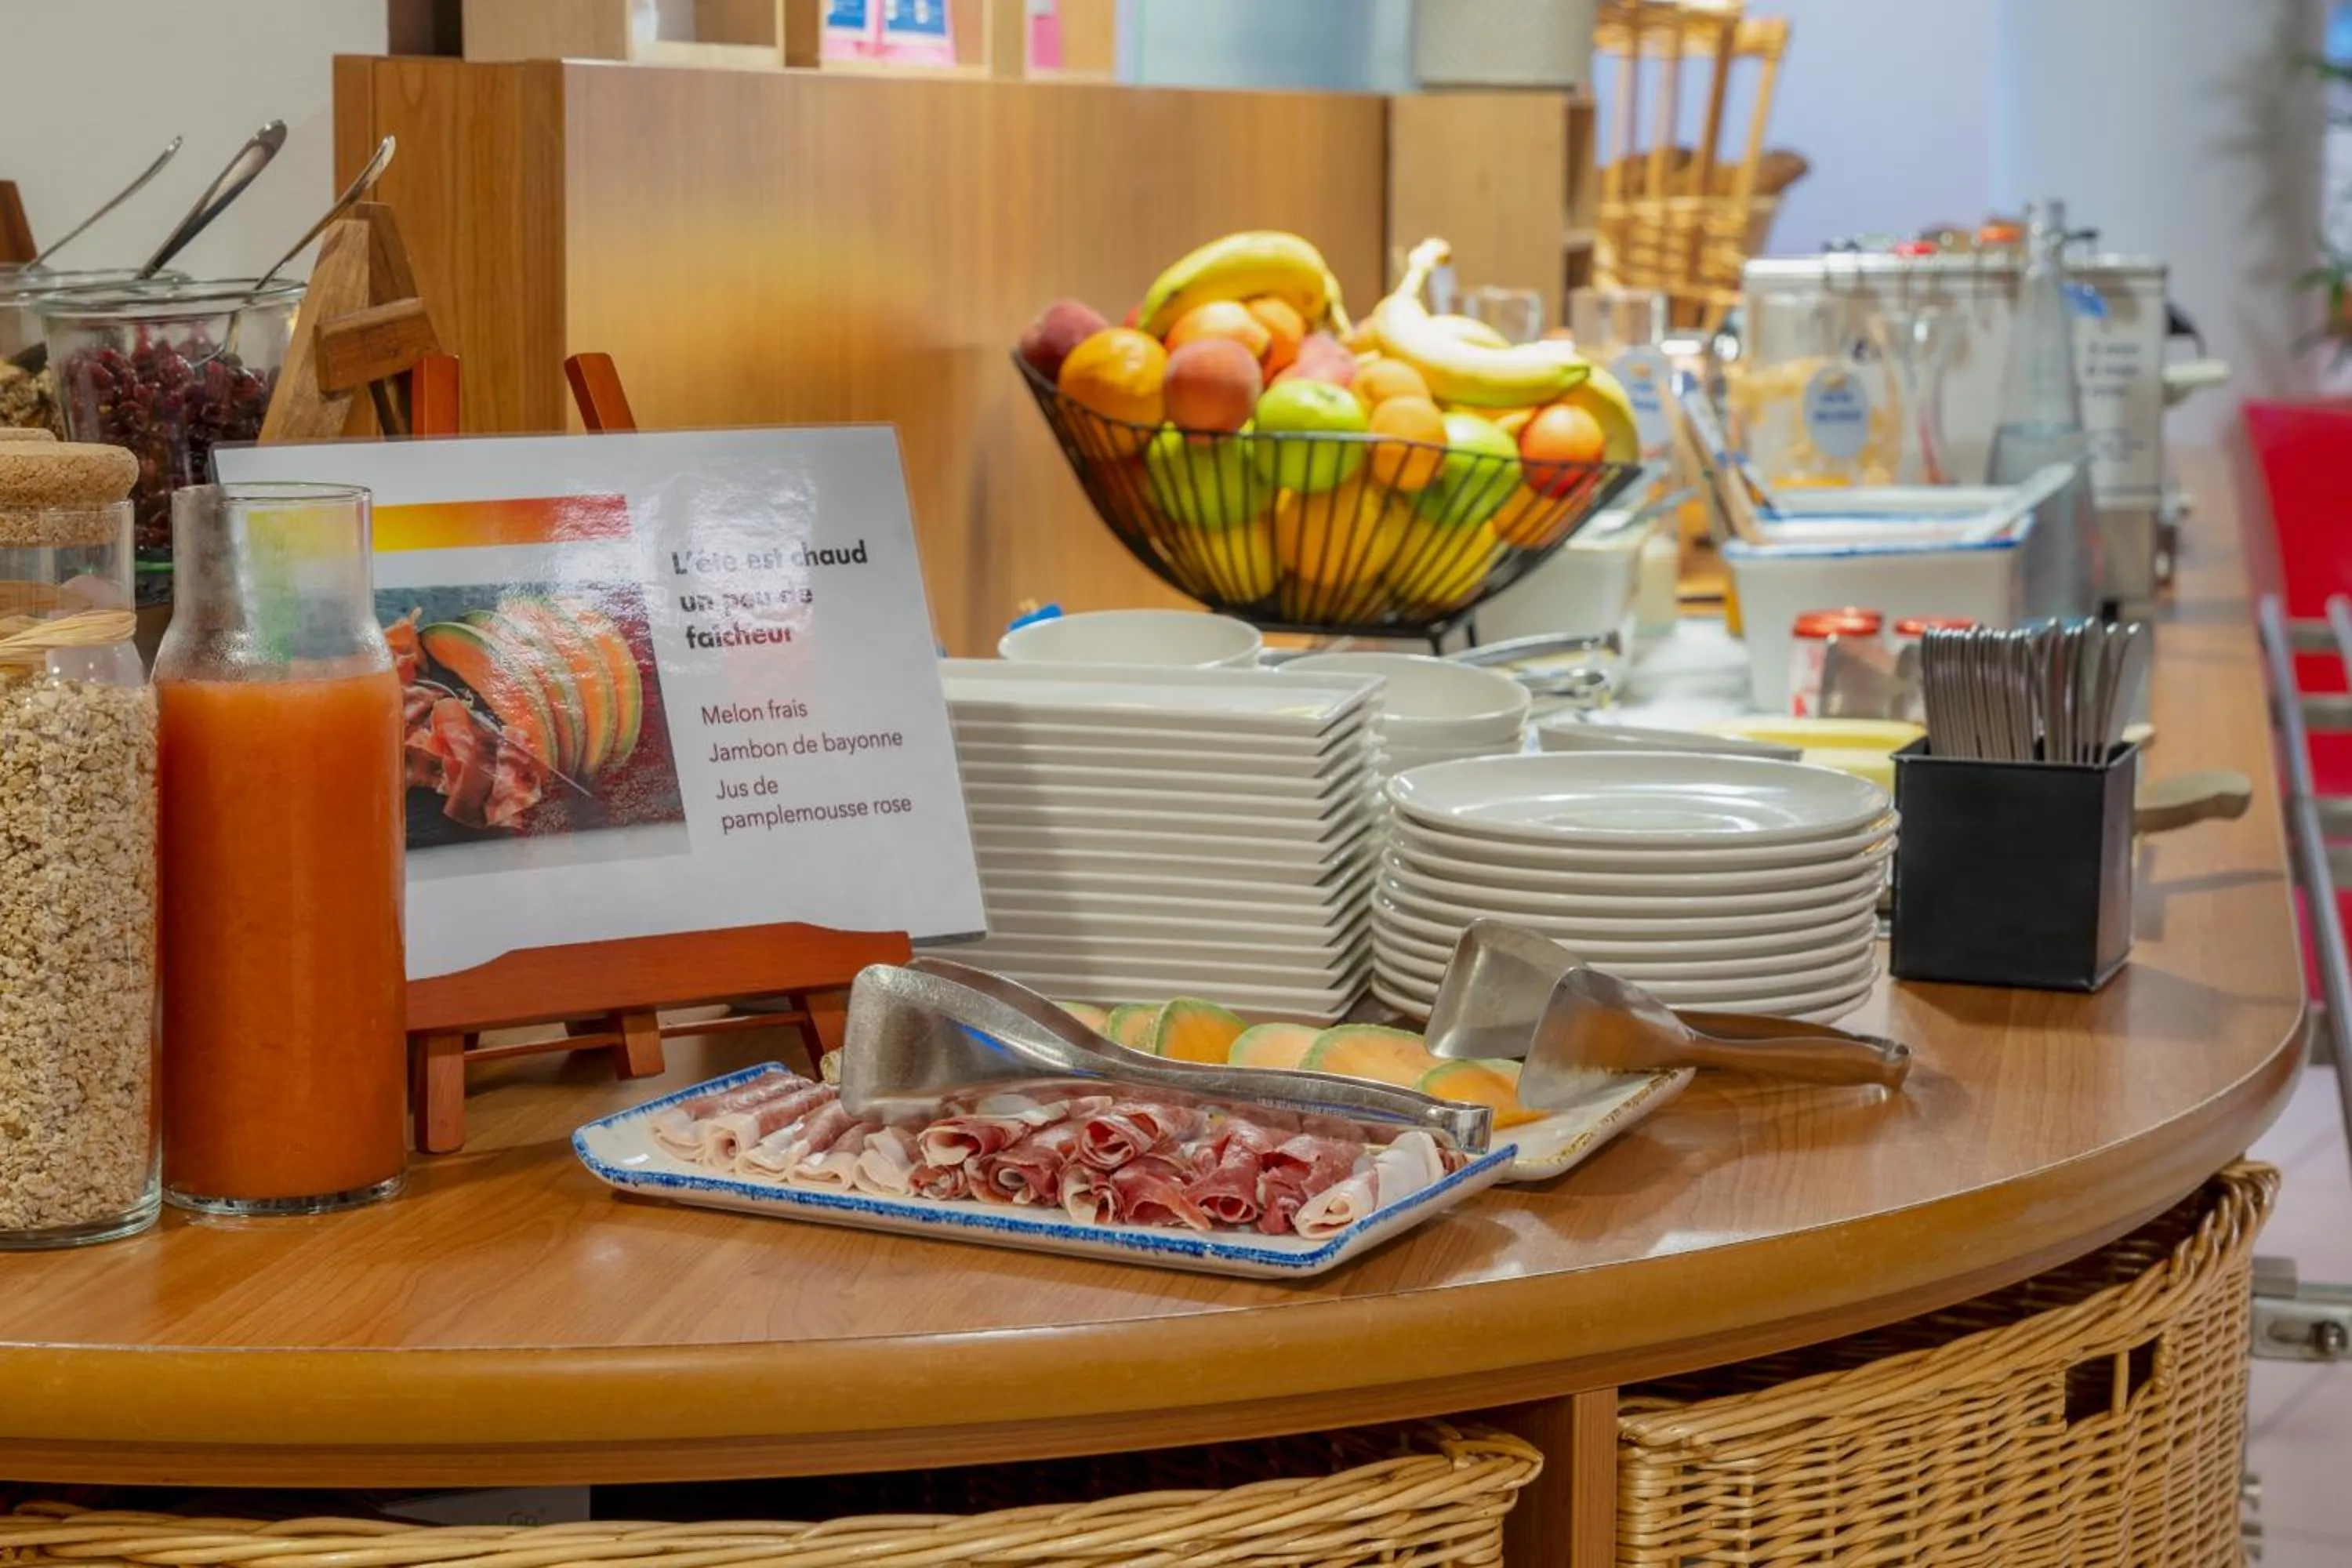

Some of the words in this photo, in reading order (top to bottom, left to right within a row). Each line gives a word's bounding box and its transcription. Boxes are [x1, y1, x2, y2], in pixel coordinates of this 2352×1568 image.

[747, 547, 785, 570] est
[791, 539, 868, 566] chaud
[680, 593, 714, 612] un
[701, 703, 764, 726] Melon
[768, 699, 808, 720] frais
[709, 739, 789, 763] Jambon
[793, 734, 818, 754] de
[822, 730, 903, 755] bayonne
[716, 779, 749, 800] Jus
[753, 775, 779, 795] de
[721, 801, 868, 835] pamplemousse
[873, 797, 913, 815] rose
